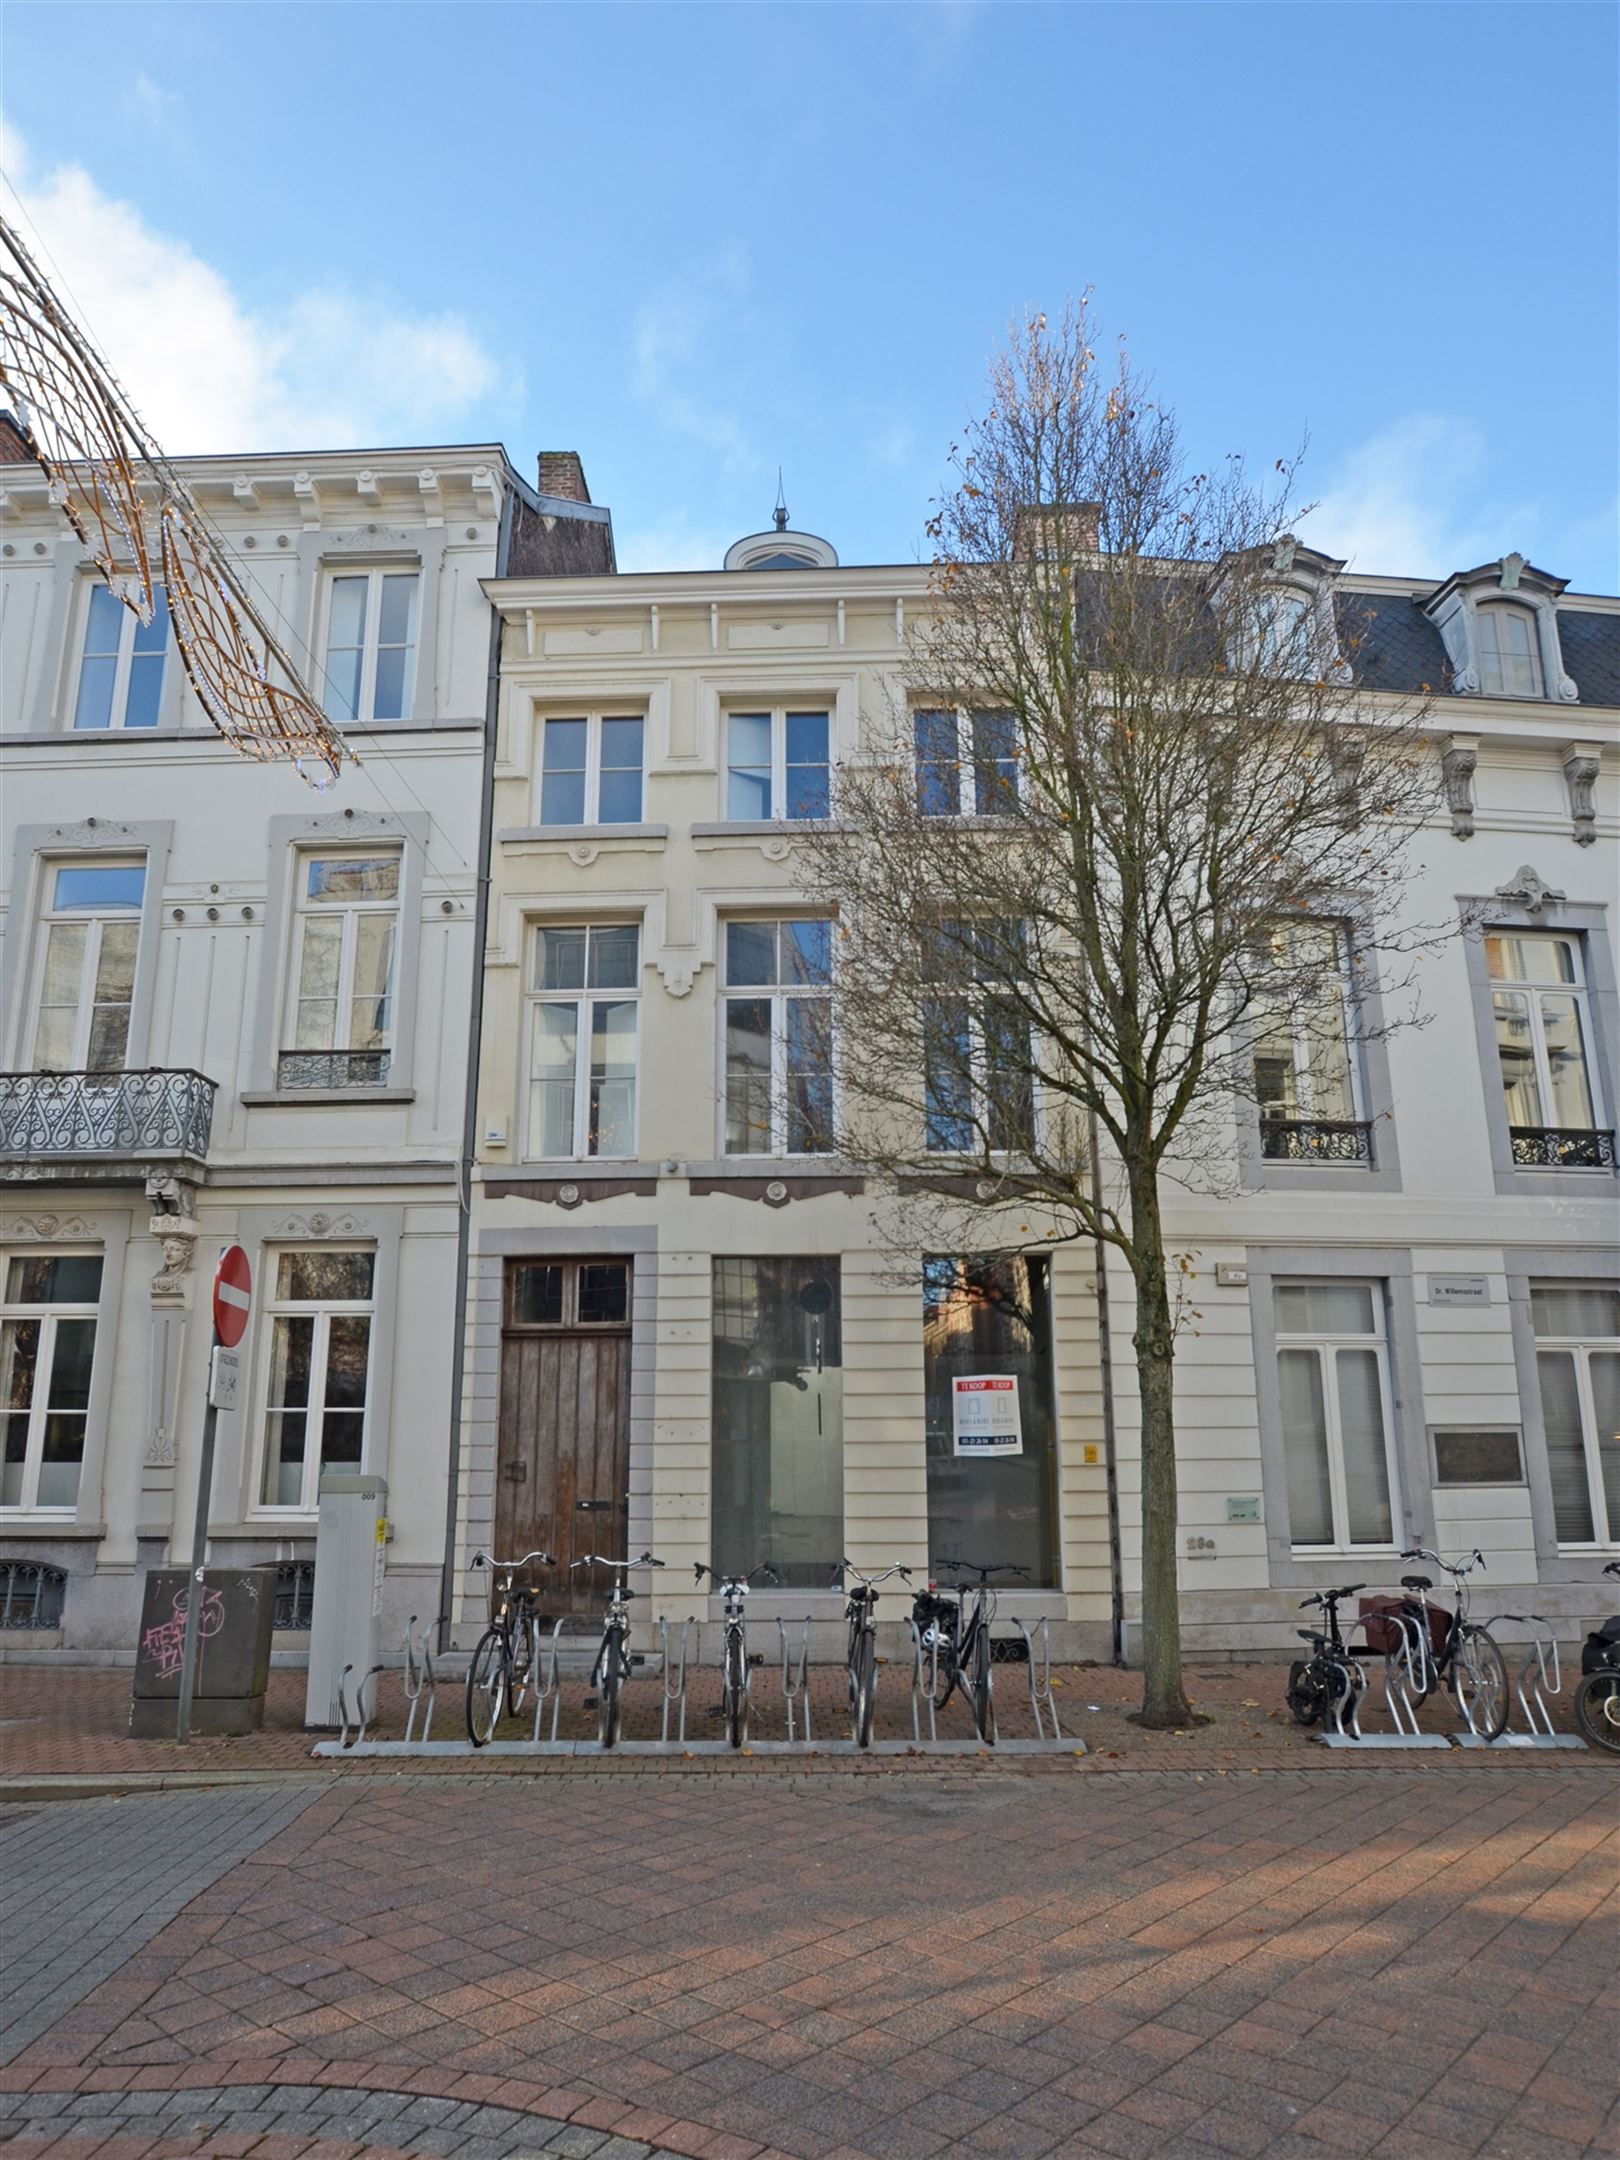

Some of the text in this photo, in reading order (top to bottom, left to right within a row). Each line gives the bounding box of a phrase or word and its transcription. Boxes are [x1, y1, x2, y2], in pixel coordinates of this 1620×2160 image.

[961, 1381, 987, 1391] TE KOOP
[361, 1492, 376, 1501] 009
